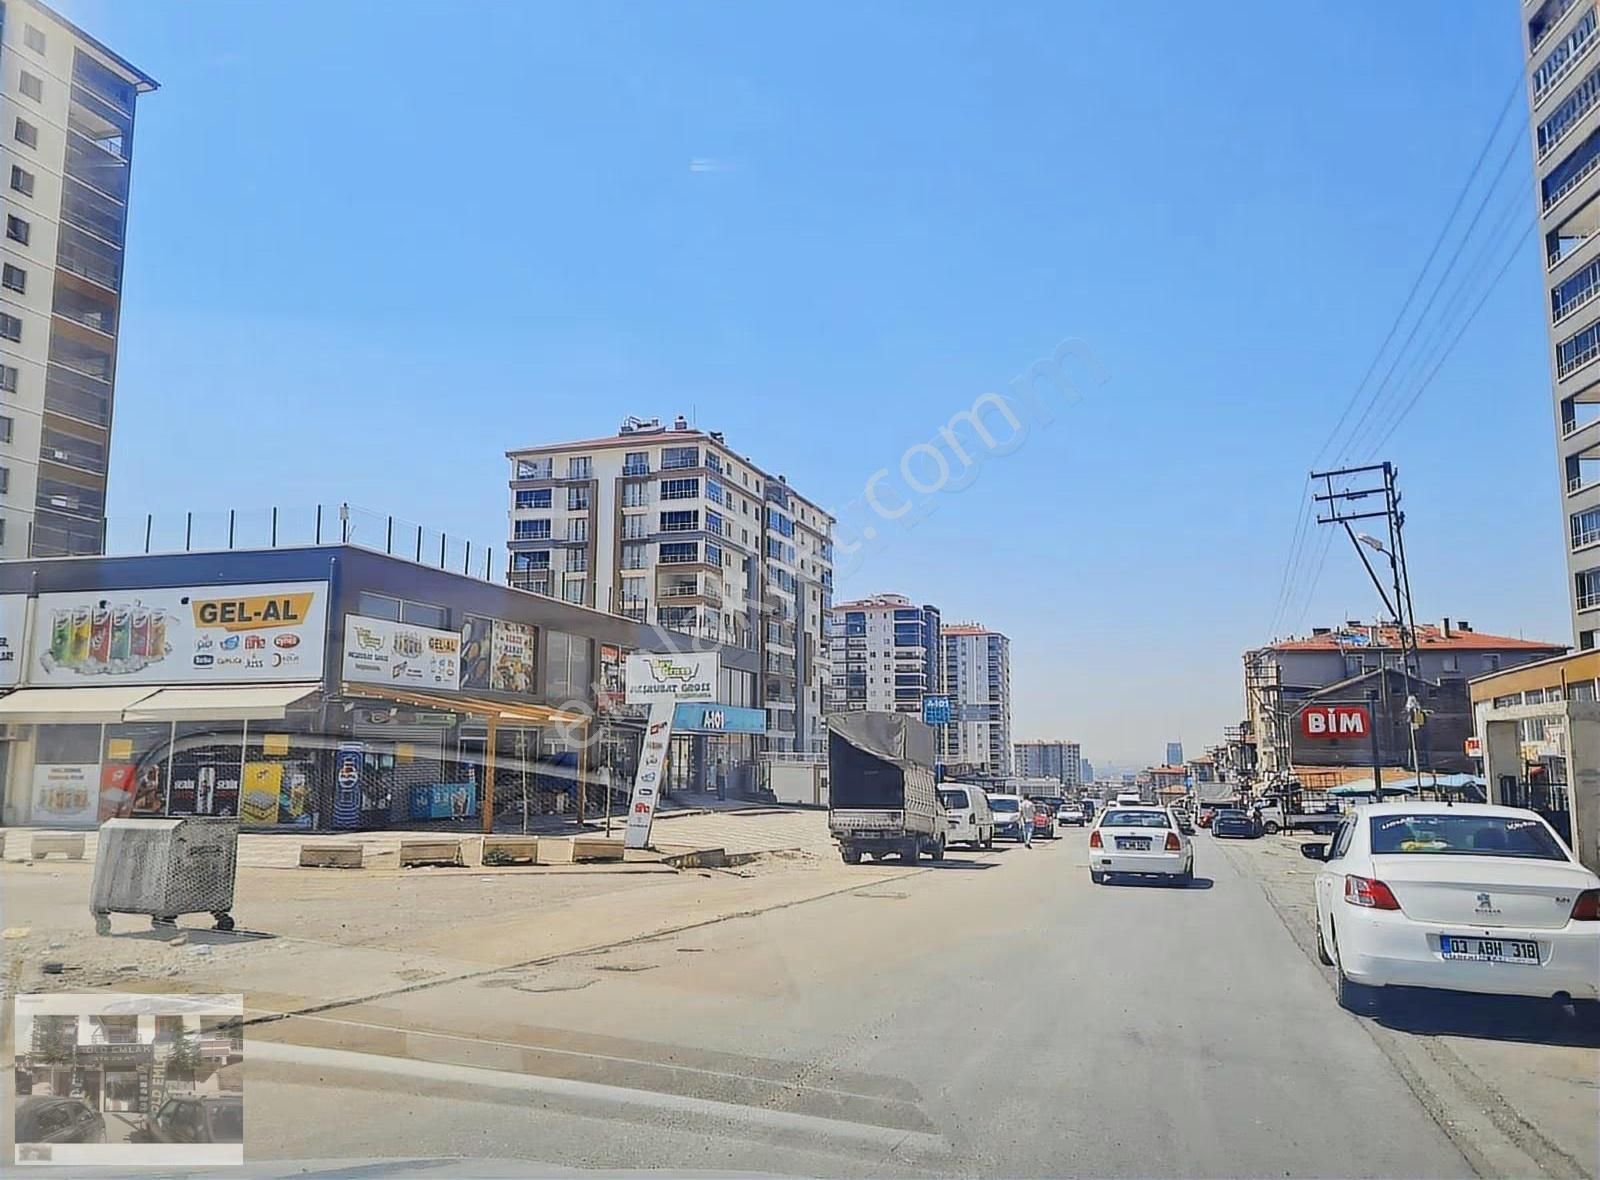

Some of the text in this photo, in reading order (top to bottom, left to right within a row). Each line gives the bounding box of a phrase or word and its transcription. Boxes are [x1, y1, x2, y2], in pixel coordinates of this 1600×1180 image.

[199, 600, 298, 623] GEL-AL
[1308, 708, 1364, 733] BİM
[1451, 940, 1467, 953] 03
[1478, 941, 1502, 956] ABH
